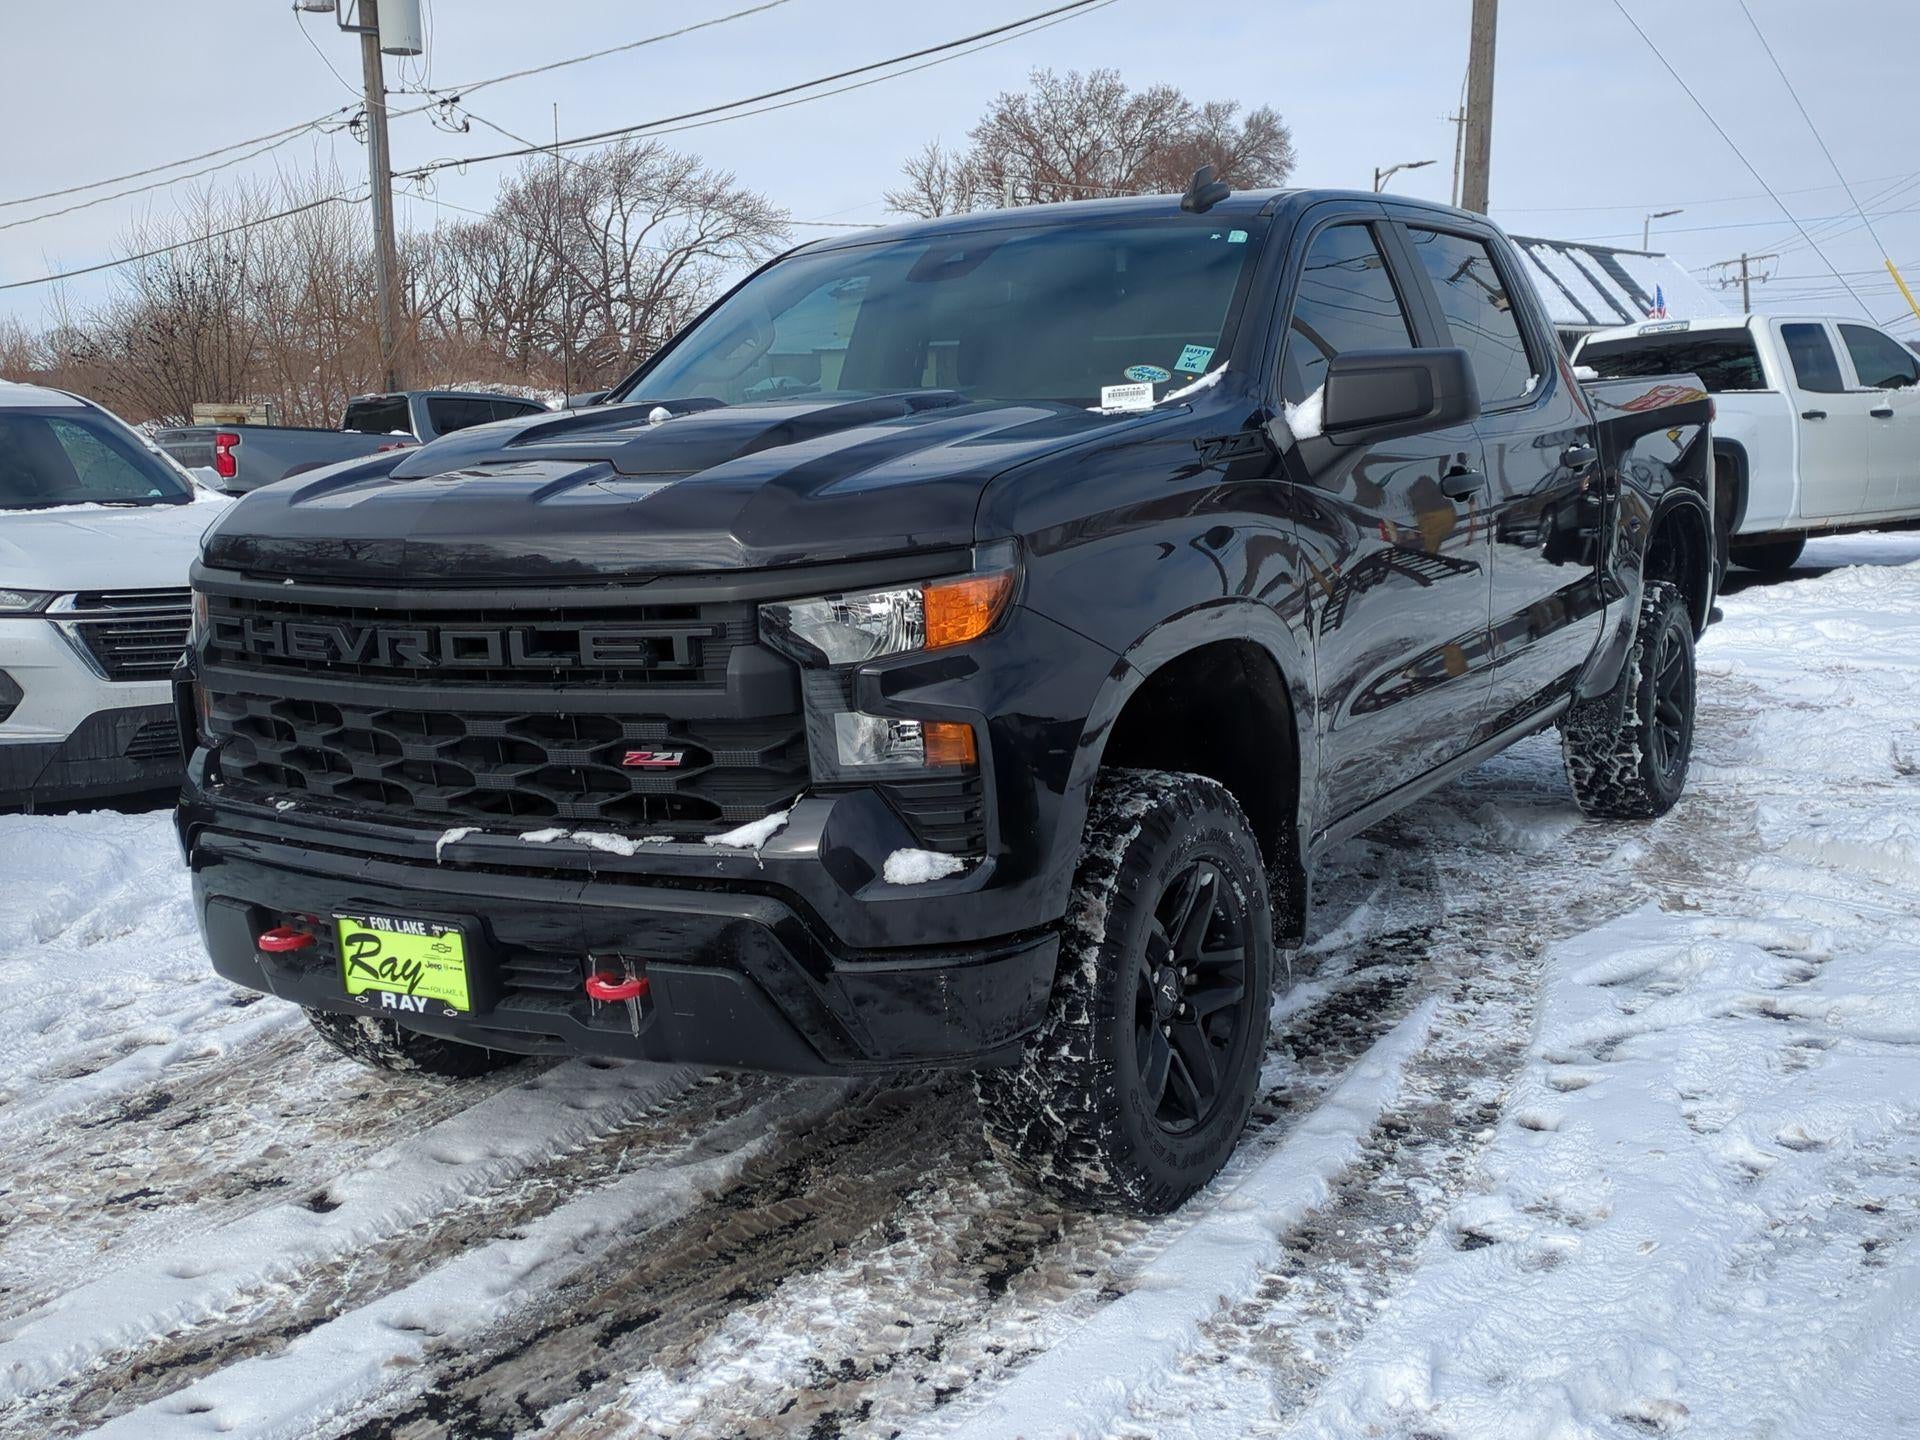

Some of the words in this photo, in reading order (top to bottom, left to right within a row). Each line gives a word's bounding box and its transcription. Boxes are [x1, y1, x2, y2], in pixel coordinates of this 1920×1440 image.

[1185, 346, 1211, 356] SAFETY
[208, 614, 725, 667] CHEVROLET
[622, 751, 683, 766] Z71
[369, 916, 394, 932] FOX
[394, 919, 426, 935] LAKE
[345, 932, 425, 994] Ray
[425, 960, 443, 971] Jeep
[381, 991, 428, 1013] RAY
